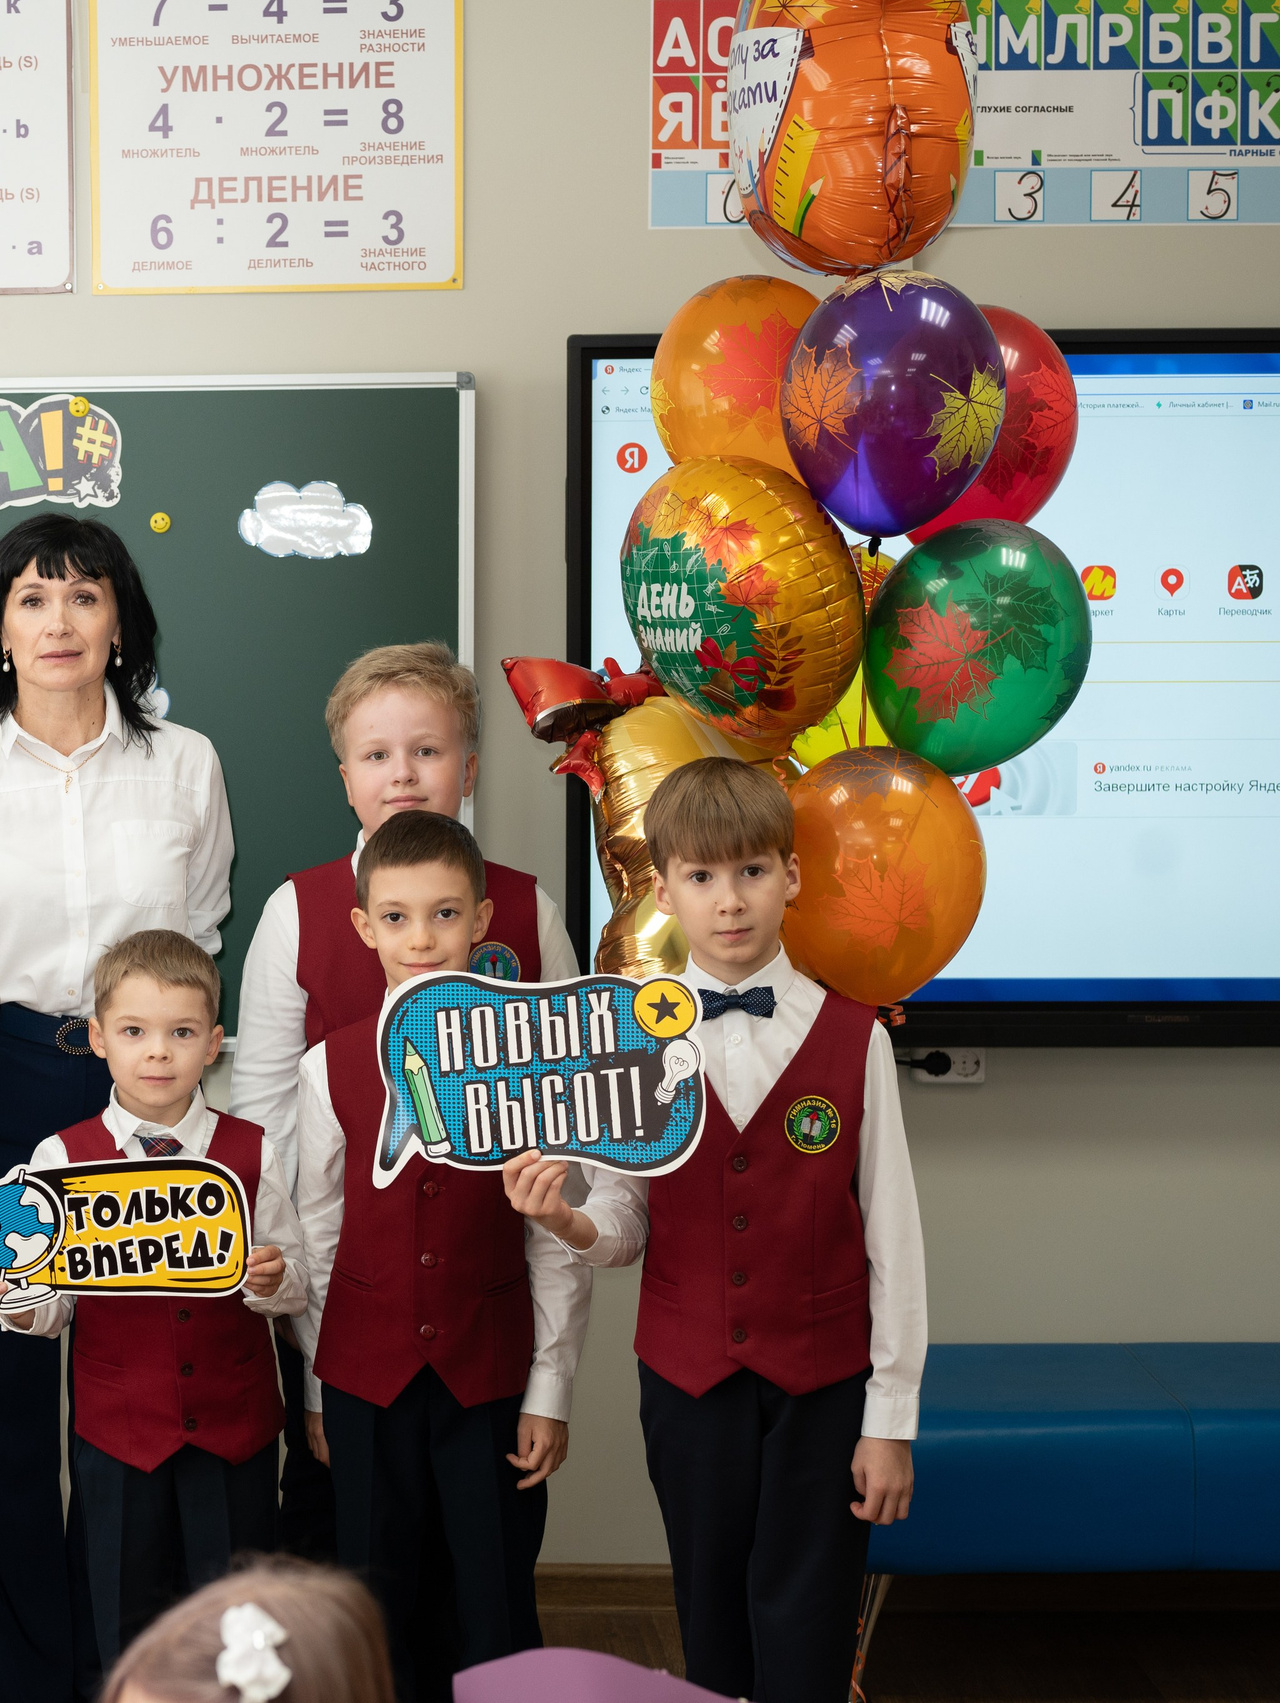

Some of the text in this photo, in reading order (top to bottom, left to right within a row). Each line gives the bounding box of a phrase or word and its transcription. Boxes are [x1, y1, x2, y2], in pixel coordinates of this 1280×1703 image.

[231, 32, 320, 45] ВЫЧИТАЕМОЕ
[359, 28, 426, 39] ЗНАЧЕНИЕ
[110, 35, 210, 48] УМЕНЬШАЕМОЕ
[359, 41, 426, 54] РАЗНОСТИ
[17, 55, 39, 72] (S)
[157, 60, 396, 94] УМНОЖЕНИЕ
[1014, 104, 1074, 113] СОГЛАСНЫЕ
[148, 98, 405, 140] 4 2 8
[239, 145, 320, 158] МНОЖИТЕЛЬ
[359, 140, 426, 152] ЗНАЧЕНИЕ
[1229, 148, 1276, 157] ПАРНЫЕ
[121, 147, 201, 160] МНОЖИТЕЛЬ
[341, 153, 444, 167] ПРОИЗВЕДЕНИЯ
[19, 187, 41, 204] (S)
[189, 173, 364, 210] ДЕЛЕНИЕ
[149, 209, 405, 250] 6 2 3
[360, 247, 427, 259] ЗНАЧЕНИЕ
[131, 260, 193, 273] ДЕЛИМОЕ
[247, 257, 314, 271] ДЕЛИТЕЛЬ
[360, 260, 427, 273] ЧАСТНОГО
[618, 366, 642, 374] Яндекс
[615, 406, 639, 414] Яндекс
[1168, 401, 1196, 409] Личный
[636, 581, 696, 623] ДЕНЬ
[1089, 609, 1115, 618] аркет
[1157, 607, 1186, 618] Карты
[1218, 607, 1273, 618] Переводчик
[639, 622, 704, 653] ЗНАНИЙ
[1109, 763, 1152, 773] yandex.ru
[1094, 780, 1171, 794] Завершите
[1175, 780, 1245, 794] настройку
[436, 991, 615, 1073] НОВЫХ
[465, 1066, 644, 1154] ВЫСОТ!
[790, 1100, 827, 1119] ГИМНАЗИЯ
[65, 1180, 228, 1233] ТОЛЬКО
[66, 1227, 236, 1282] ВПЕРЕД!
